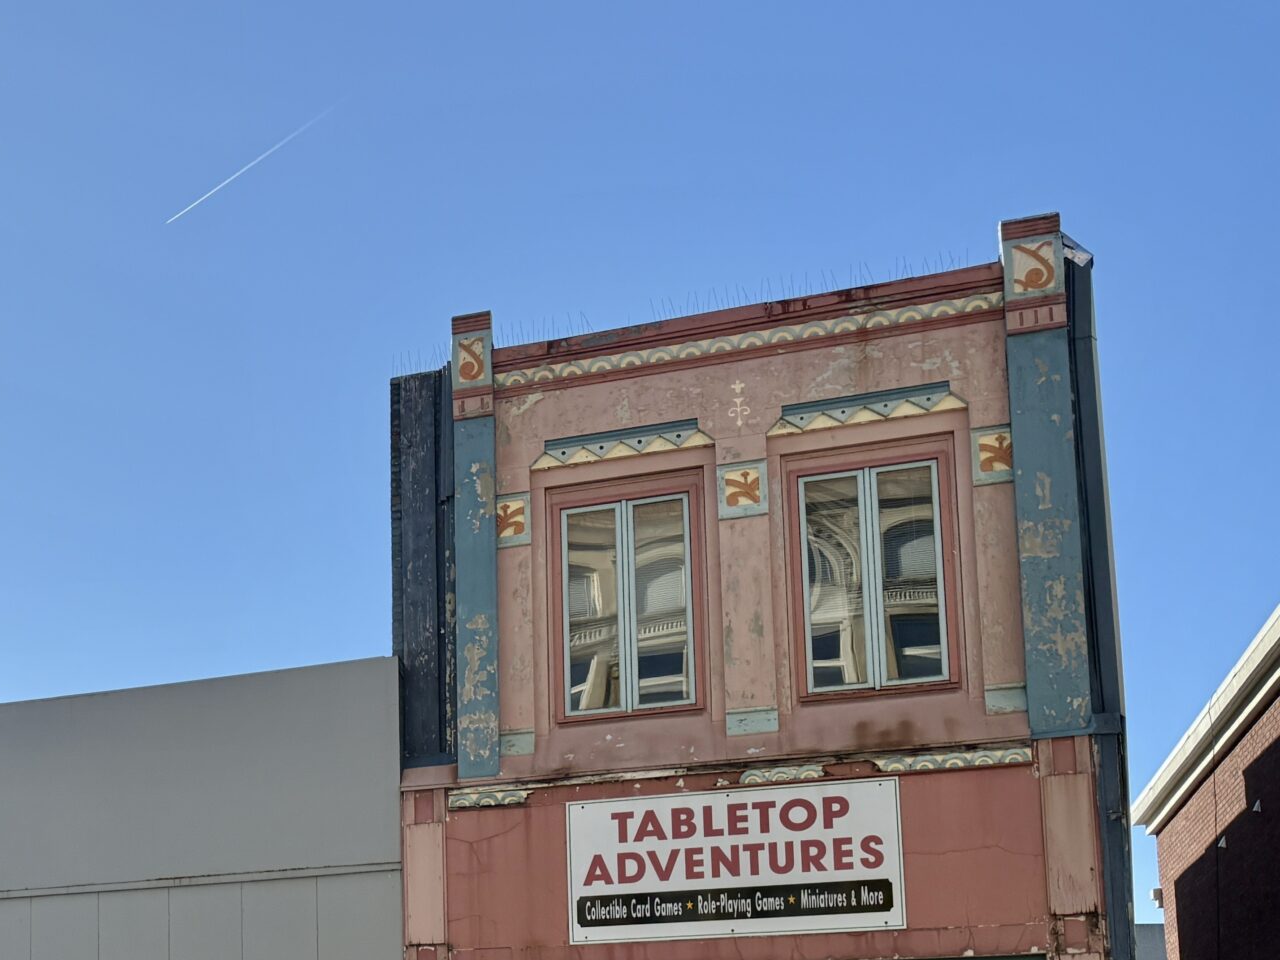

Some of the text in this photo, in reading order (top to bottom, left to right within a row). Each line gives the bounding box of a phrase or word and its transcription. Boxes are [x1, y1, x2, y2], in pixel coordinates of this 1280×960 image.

[611, 796, 850, 843] TABLETOP
[583, 835, 885, 887] ADVENTURES
[585, 885, 884, 921] Collectible Card Games Role-Playing Games Miniatures & More
